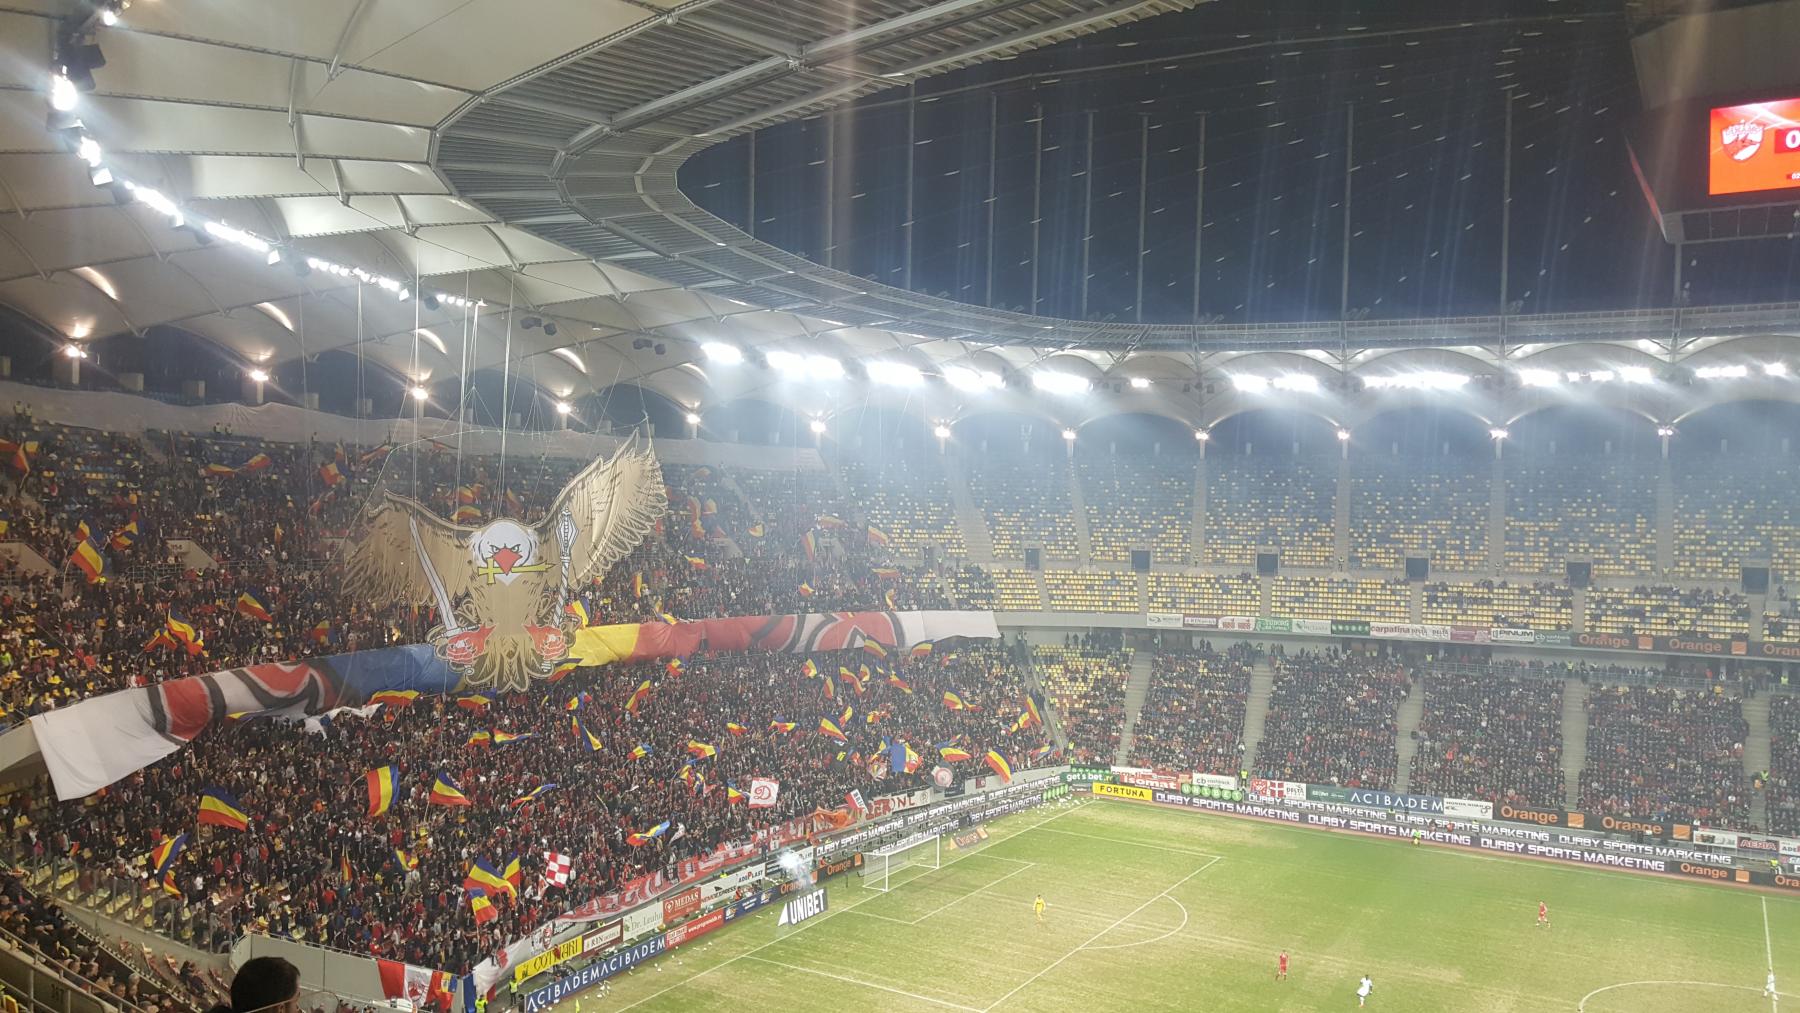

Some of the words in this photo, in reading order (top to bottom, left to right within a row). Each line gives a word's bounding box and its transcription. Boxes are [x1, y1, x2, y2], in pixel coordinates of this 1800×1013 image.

[1370, 625, 1410, 635] carpatina
[1499, 630, 1533, 638] PINUM
[1669, 638, 1722, 653] Orange
[1066, 772, 1087, 782] get's
[1100, 785, 1144, 798] FORTUNA
[1156, 792, 1190, 805] DURBY
[1193, 798, 1234, 812] SPORTS
[1236, 804, 1299, 821] MARKETING
[1284, 799, 1324, 812] SPORTS
[1326, 804, 1386, 820] MARKETING
[1351, 792, 1443, 811] ACIBADEM
[1501, 805, 1558, 824] Orange
[841, 830, 868, 848] SPORTS
[868, 819, 904, 840] MARKETING
[1308, 814, 1347, 828] DURBY
[1350, 820, 1397, 835] SPORTS
[1395, 814, 1432, 827] DURBY
[1482, 825, 1550, 841] MARKETING
[1602, 816, 1663, 834] Orange
[1481, 838, 1526, 853] DURBY
[1527, 844, 1581, 861] SPORTS
[1583, 852, 1665, 872] MARKETING
[1559, 835, 1601, 848] DURBY
[1603, 840, 1653, 855] SPORTS
[1656, 847, 1732, 865] MARKETING
[828, 859, 852, 876] Orange
[1680, 863, 1728, 878] Orange
[675, 890, 699, 907] MEDAS
[790, 888, 825, 924] UNIBET
[600, 938, 665, 977] ACIBADEM
[527, 967, 600, 1012] ACIBADEM
